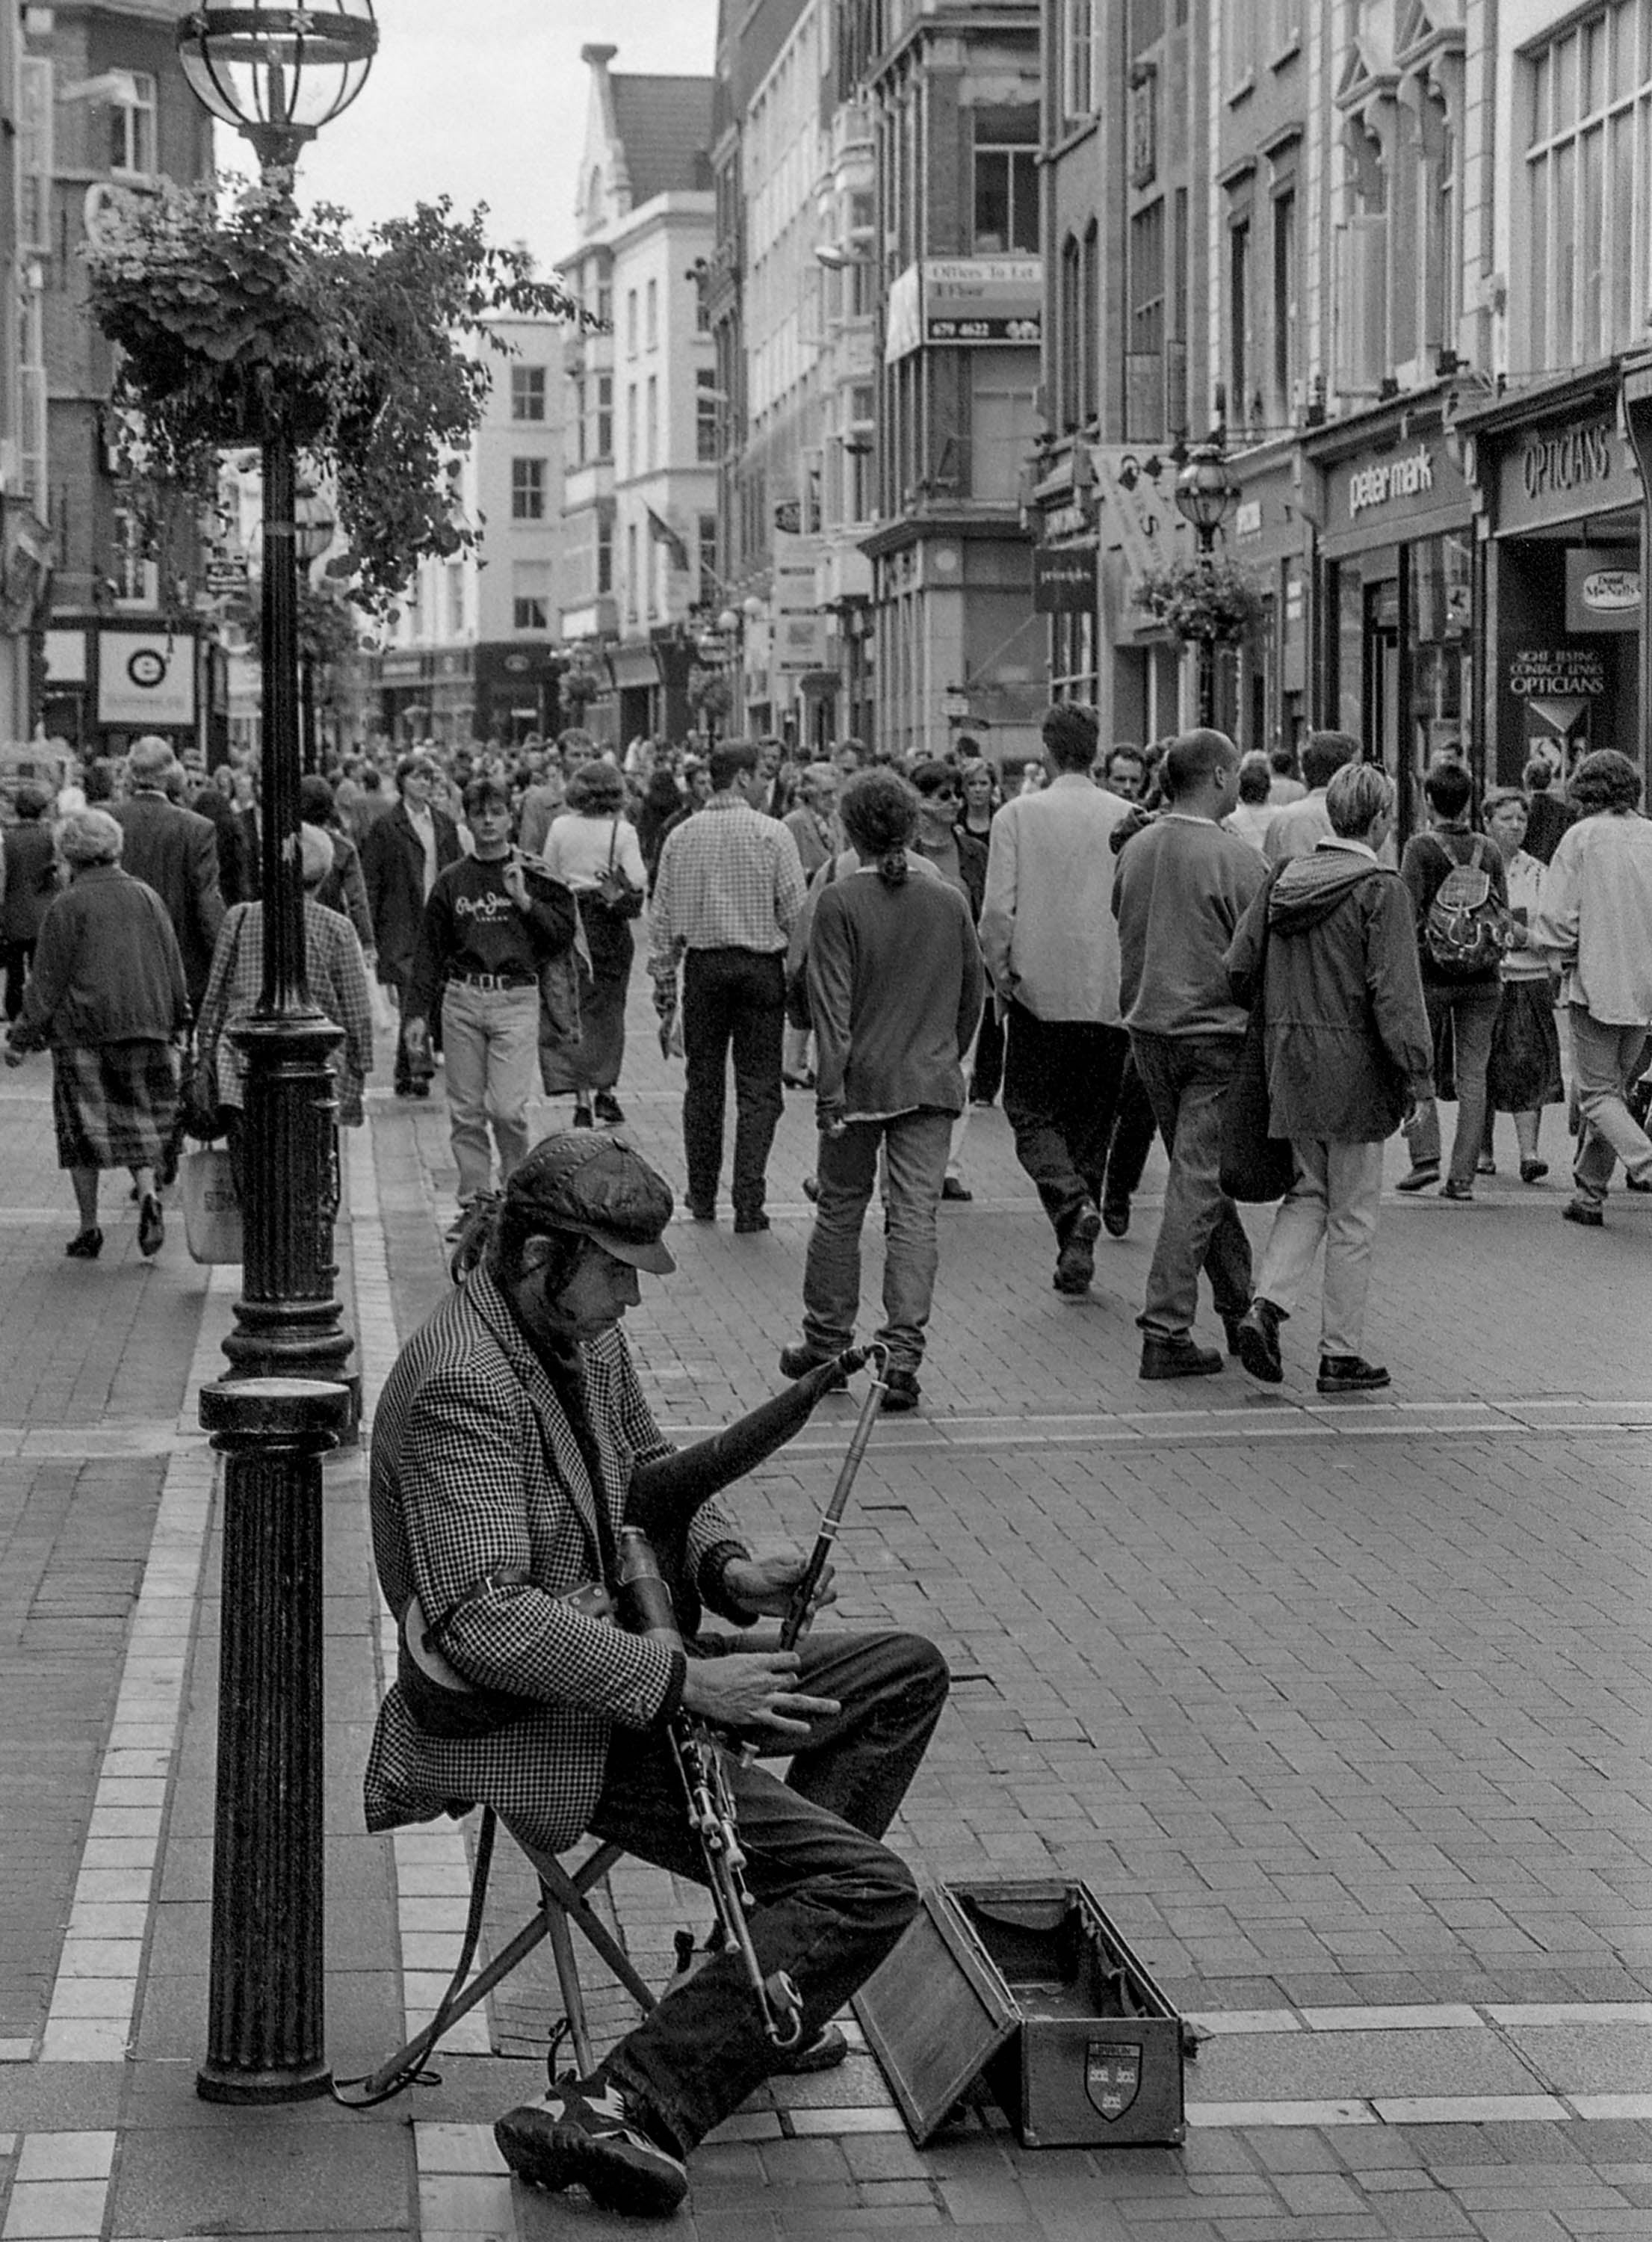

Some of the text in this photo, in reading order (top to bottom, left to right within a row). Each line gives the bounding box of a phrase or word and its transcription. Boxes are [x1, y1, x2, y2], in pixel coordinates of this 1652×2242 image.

[1349, 443, 1433, 519] peter mark
[1525, 424, 1610, 498] OPTICIANS
[1510, 676, 1604, 694] OPTICIANS
